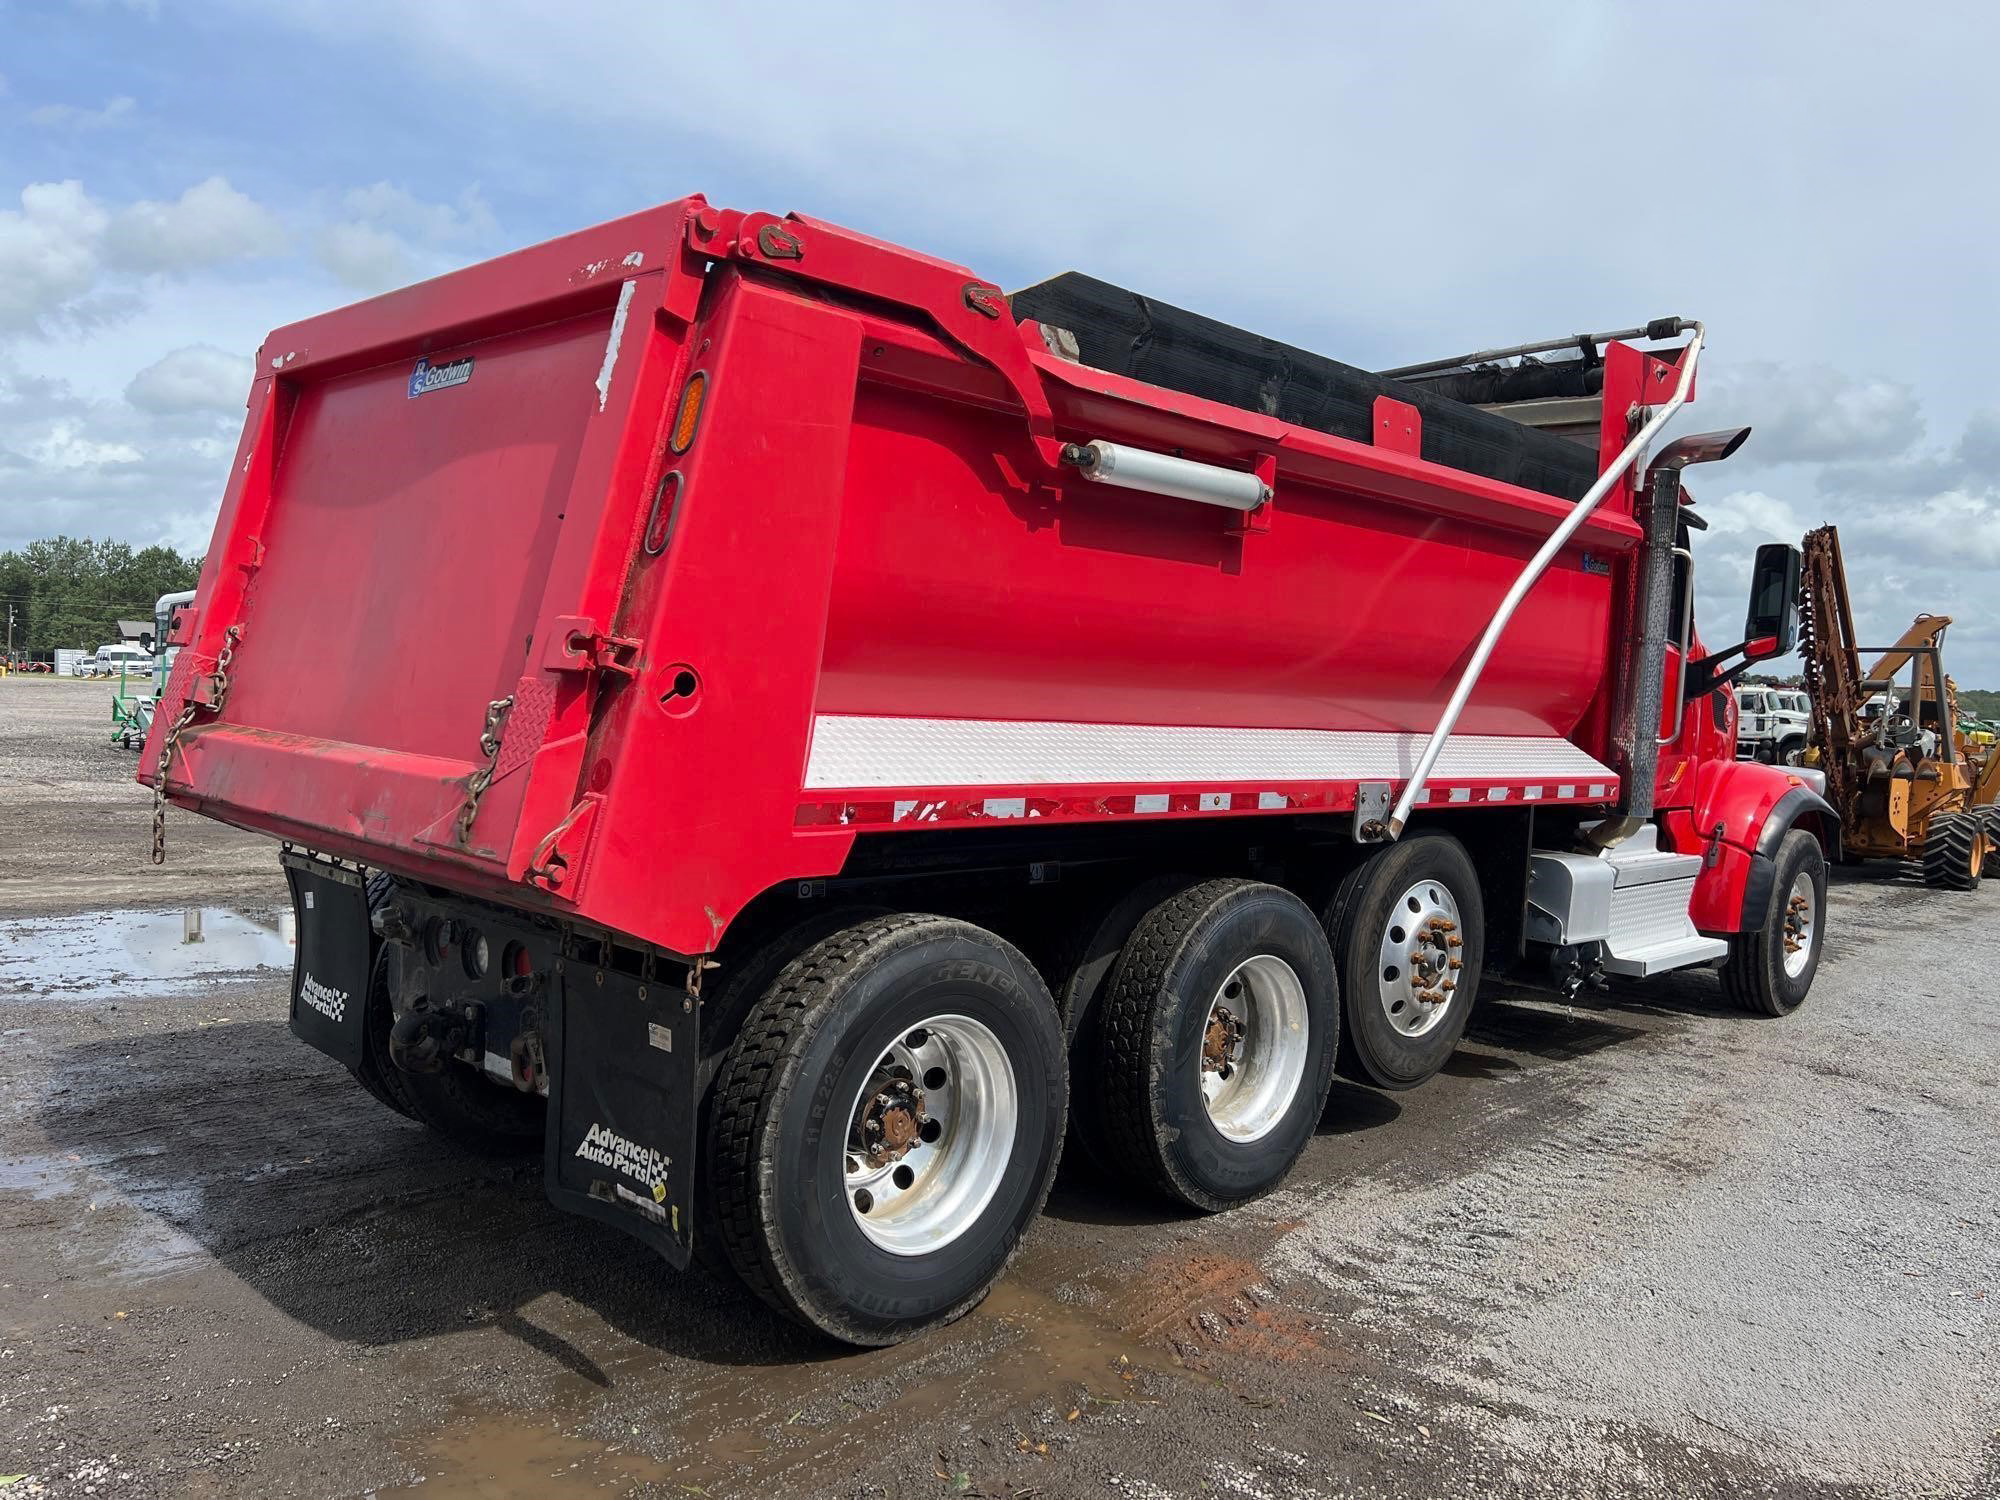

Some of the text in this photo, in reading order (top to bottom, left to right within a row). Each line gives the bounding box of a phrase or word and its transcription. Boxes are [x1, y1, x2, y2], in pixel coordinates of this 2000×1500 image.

[425, 358, 471, 386] Godwin
[575, 1140, 646, 1183] Auto Parts
[584, 1123, 649, 1165] Advance
